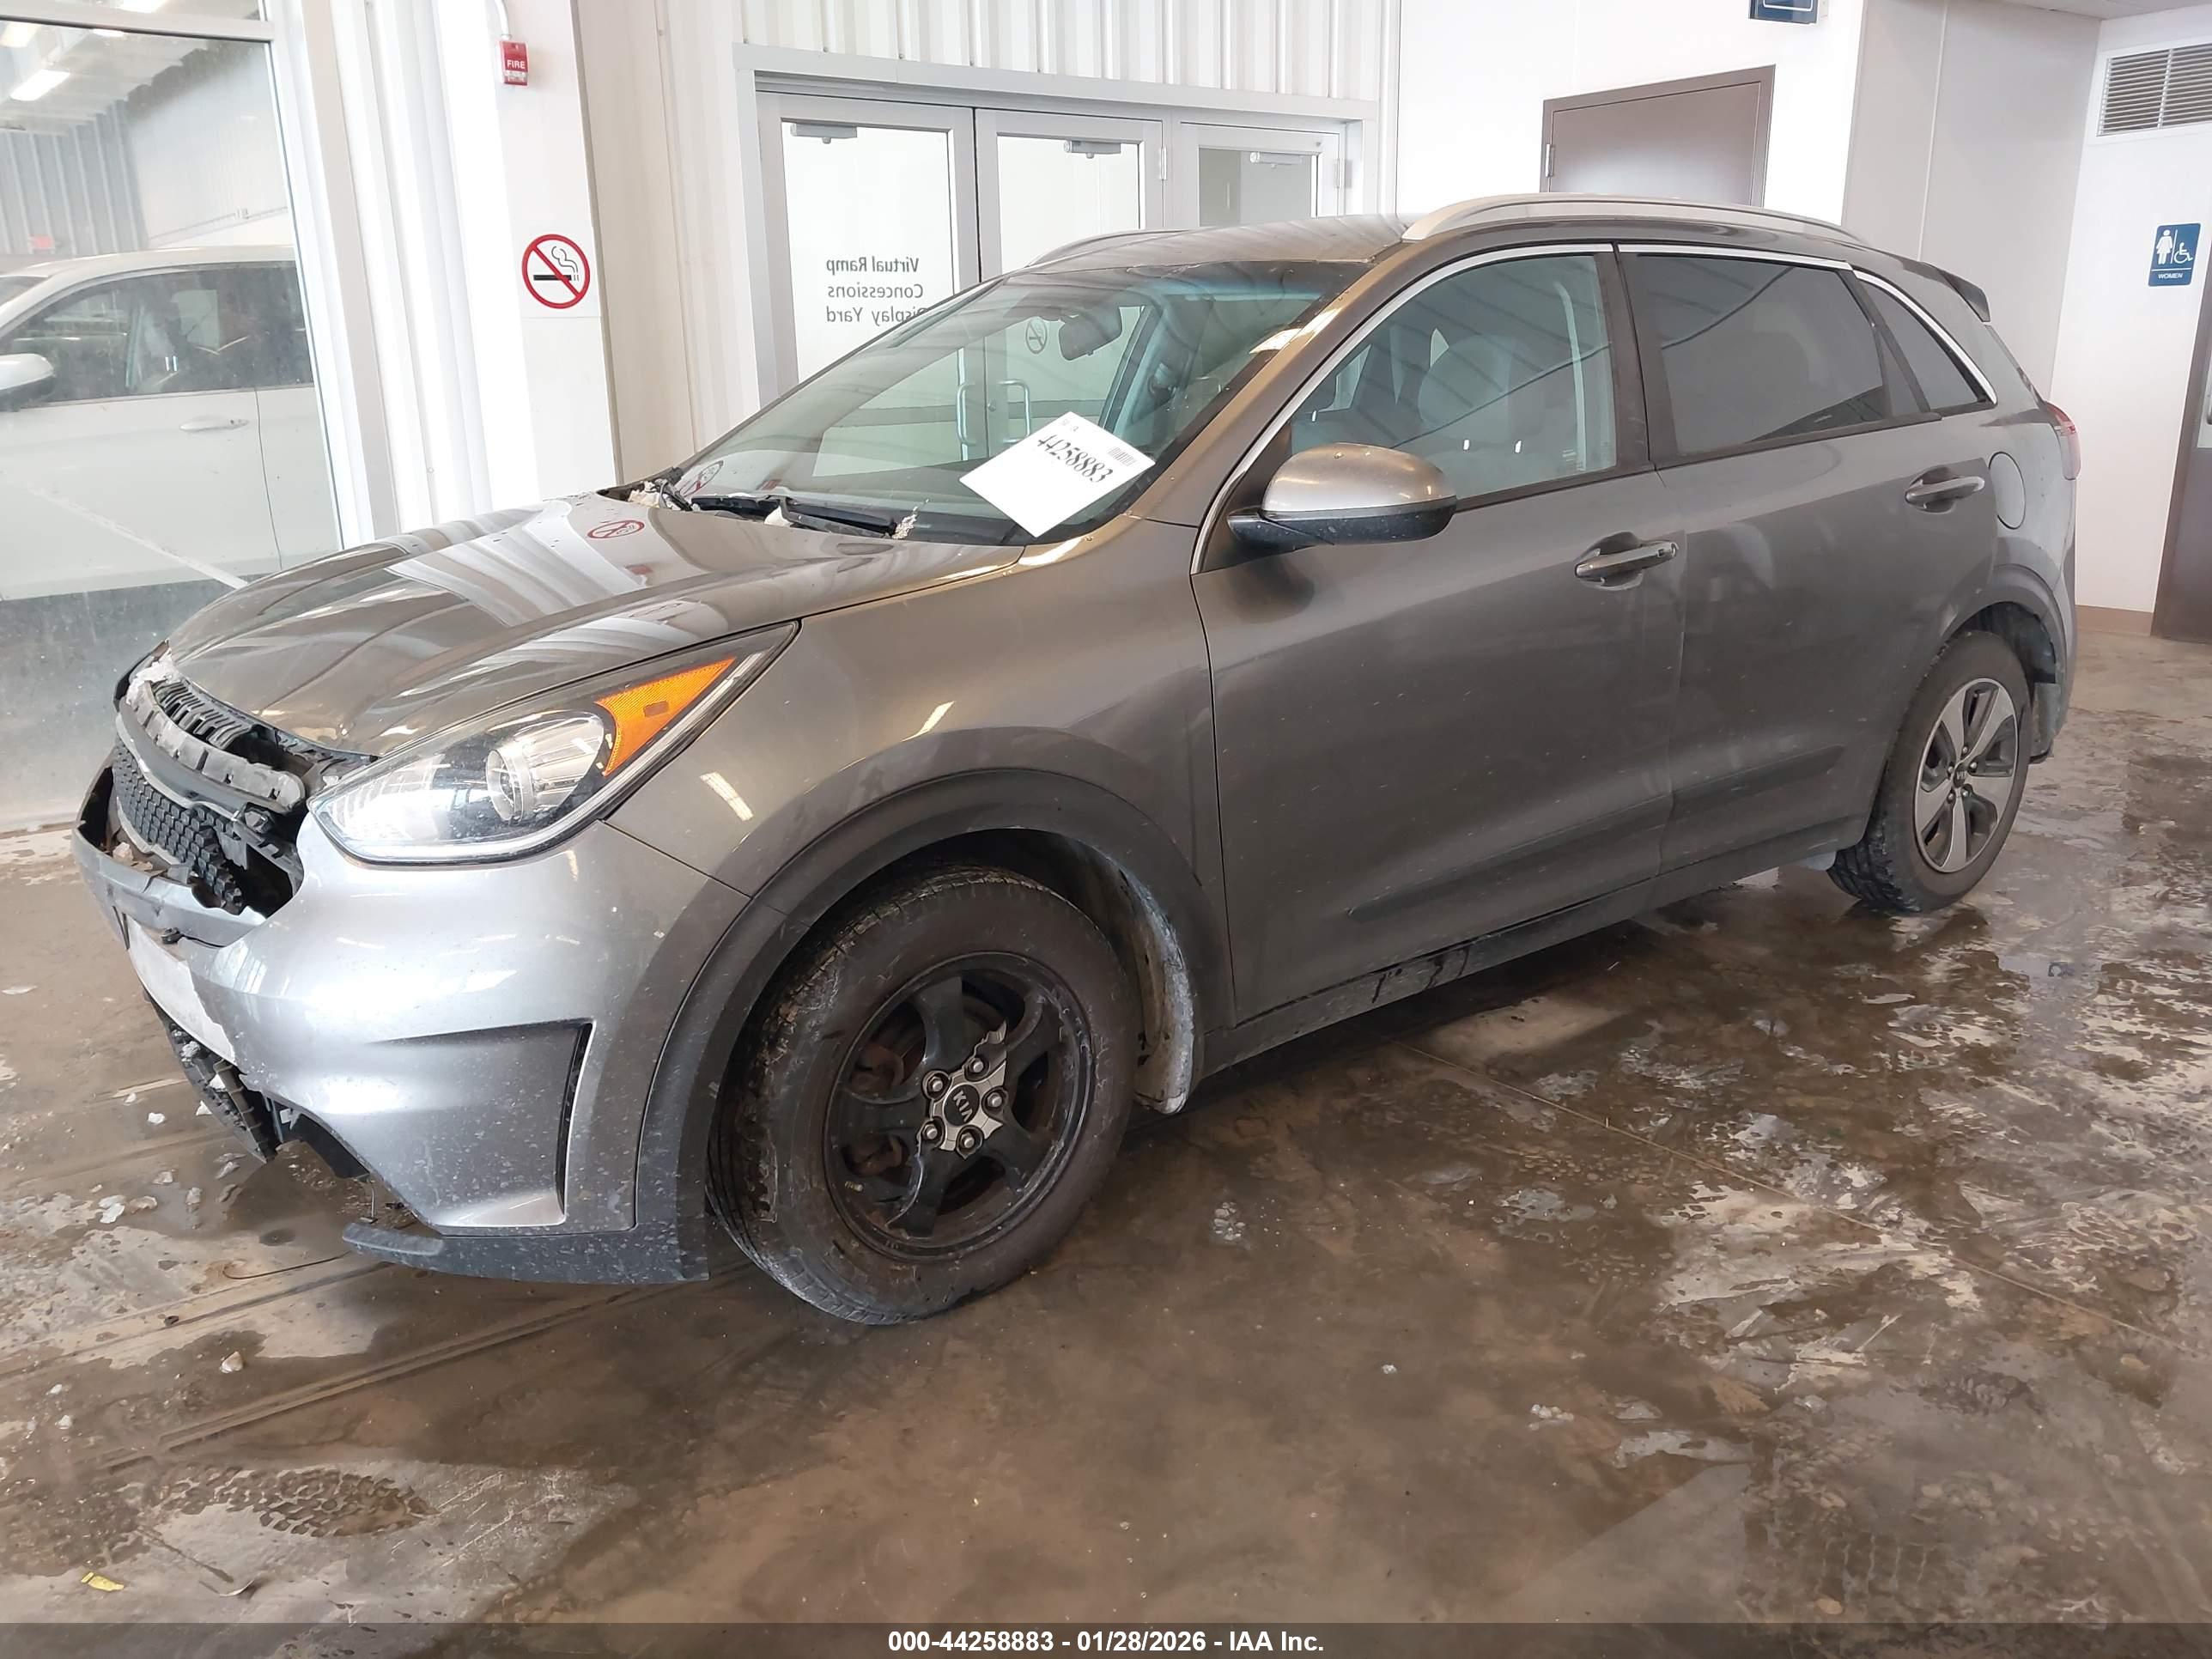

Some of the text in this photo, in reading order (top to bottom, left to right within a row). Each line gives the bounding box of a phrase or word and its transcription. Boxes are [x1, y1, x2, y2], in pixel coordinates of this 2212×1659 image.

[507, 59, 526, 70] FIRE
[1037, 434, 1114, 483] 44258883
[953, 1090, 973, 1122] KIA
